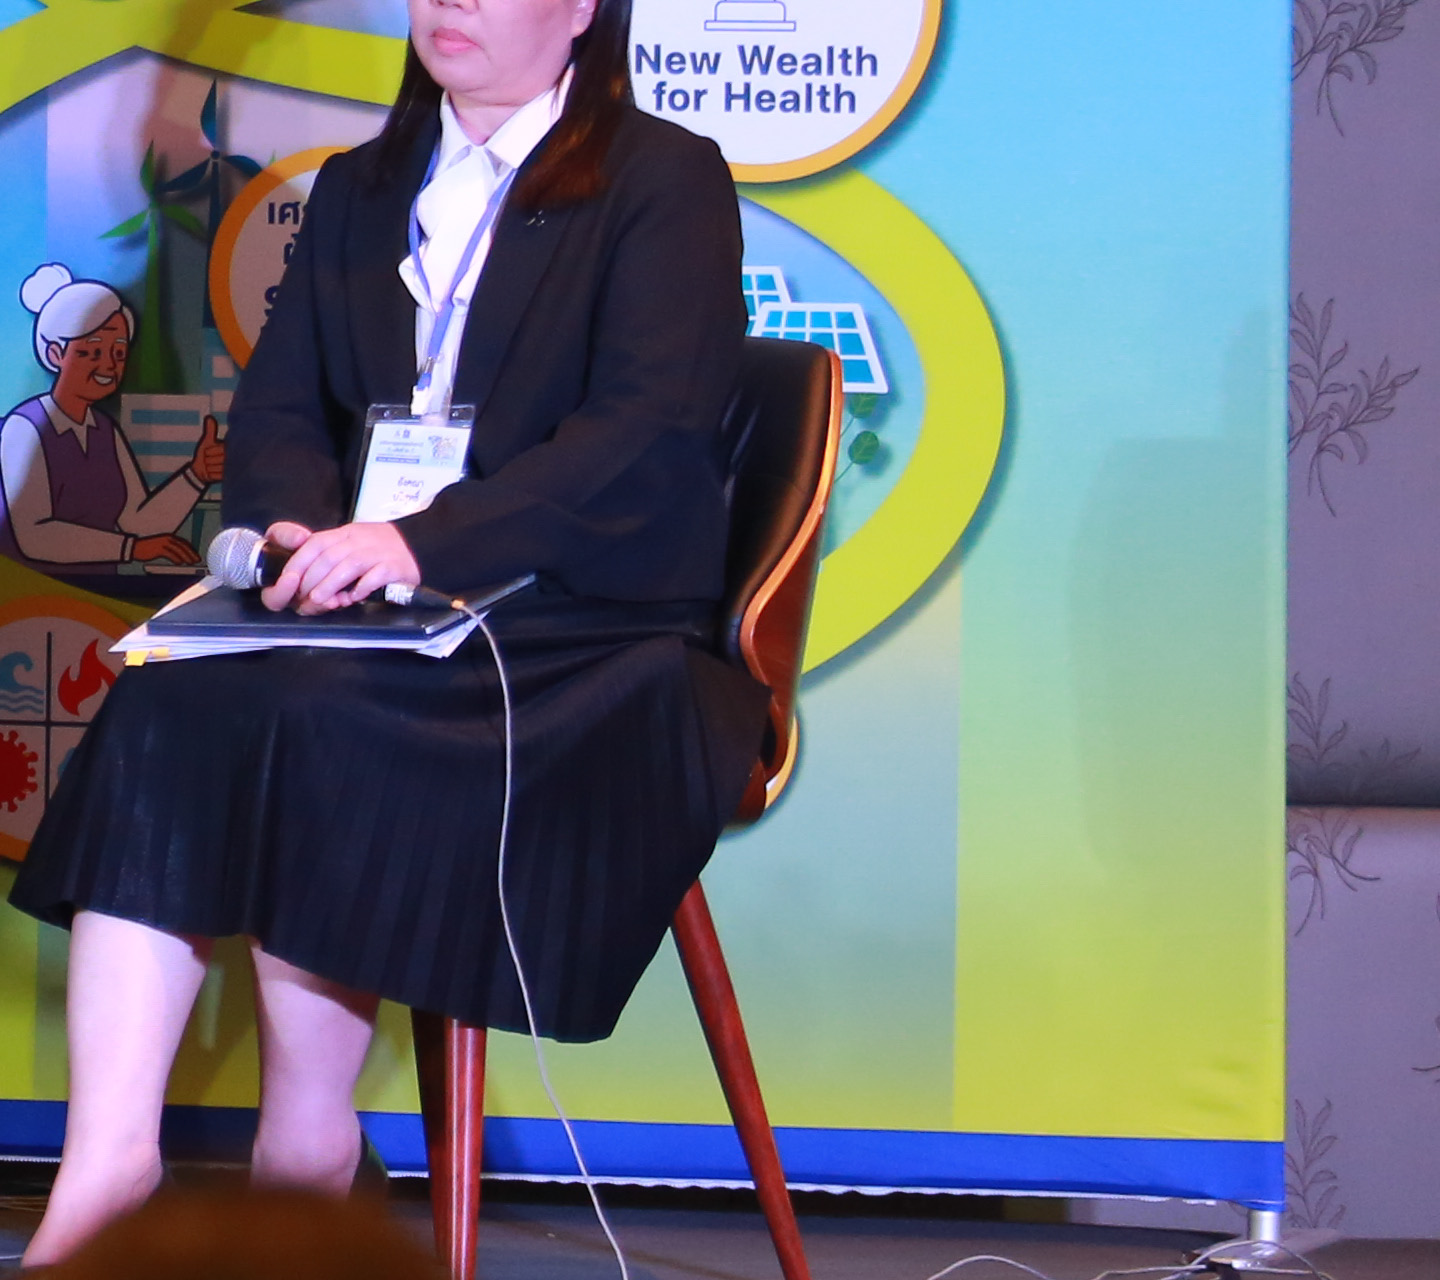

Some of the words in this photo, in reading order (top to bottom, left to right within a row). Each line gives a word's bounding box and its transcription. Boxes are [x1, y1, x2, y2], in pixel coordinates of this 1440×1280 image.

[634, 43, 722, 75] New
[736, 44, 879, 77] Wealth
[652, 80, 708, 112] for
[724, 81, 857, 114] Health
